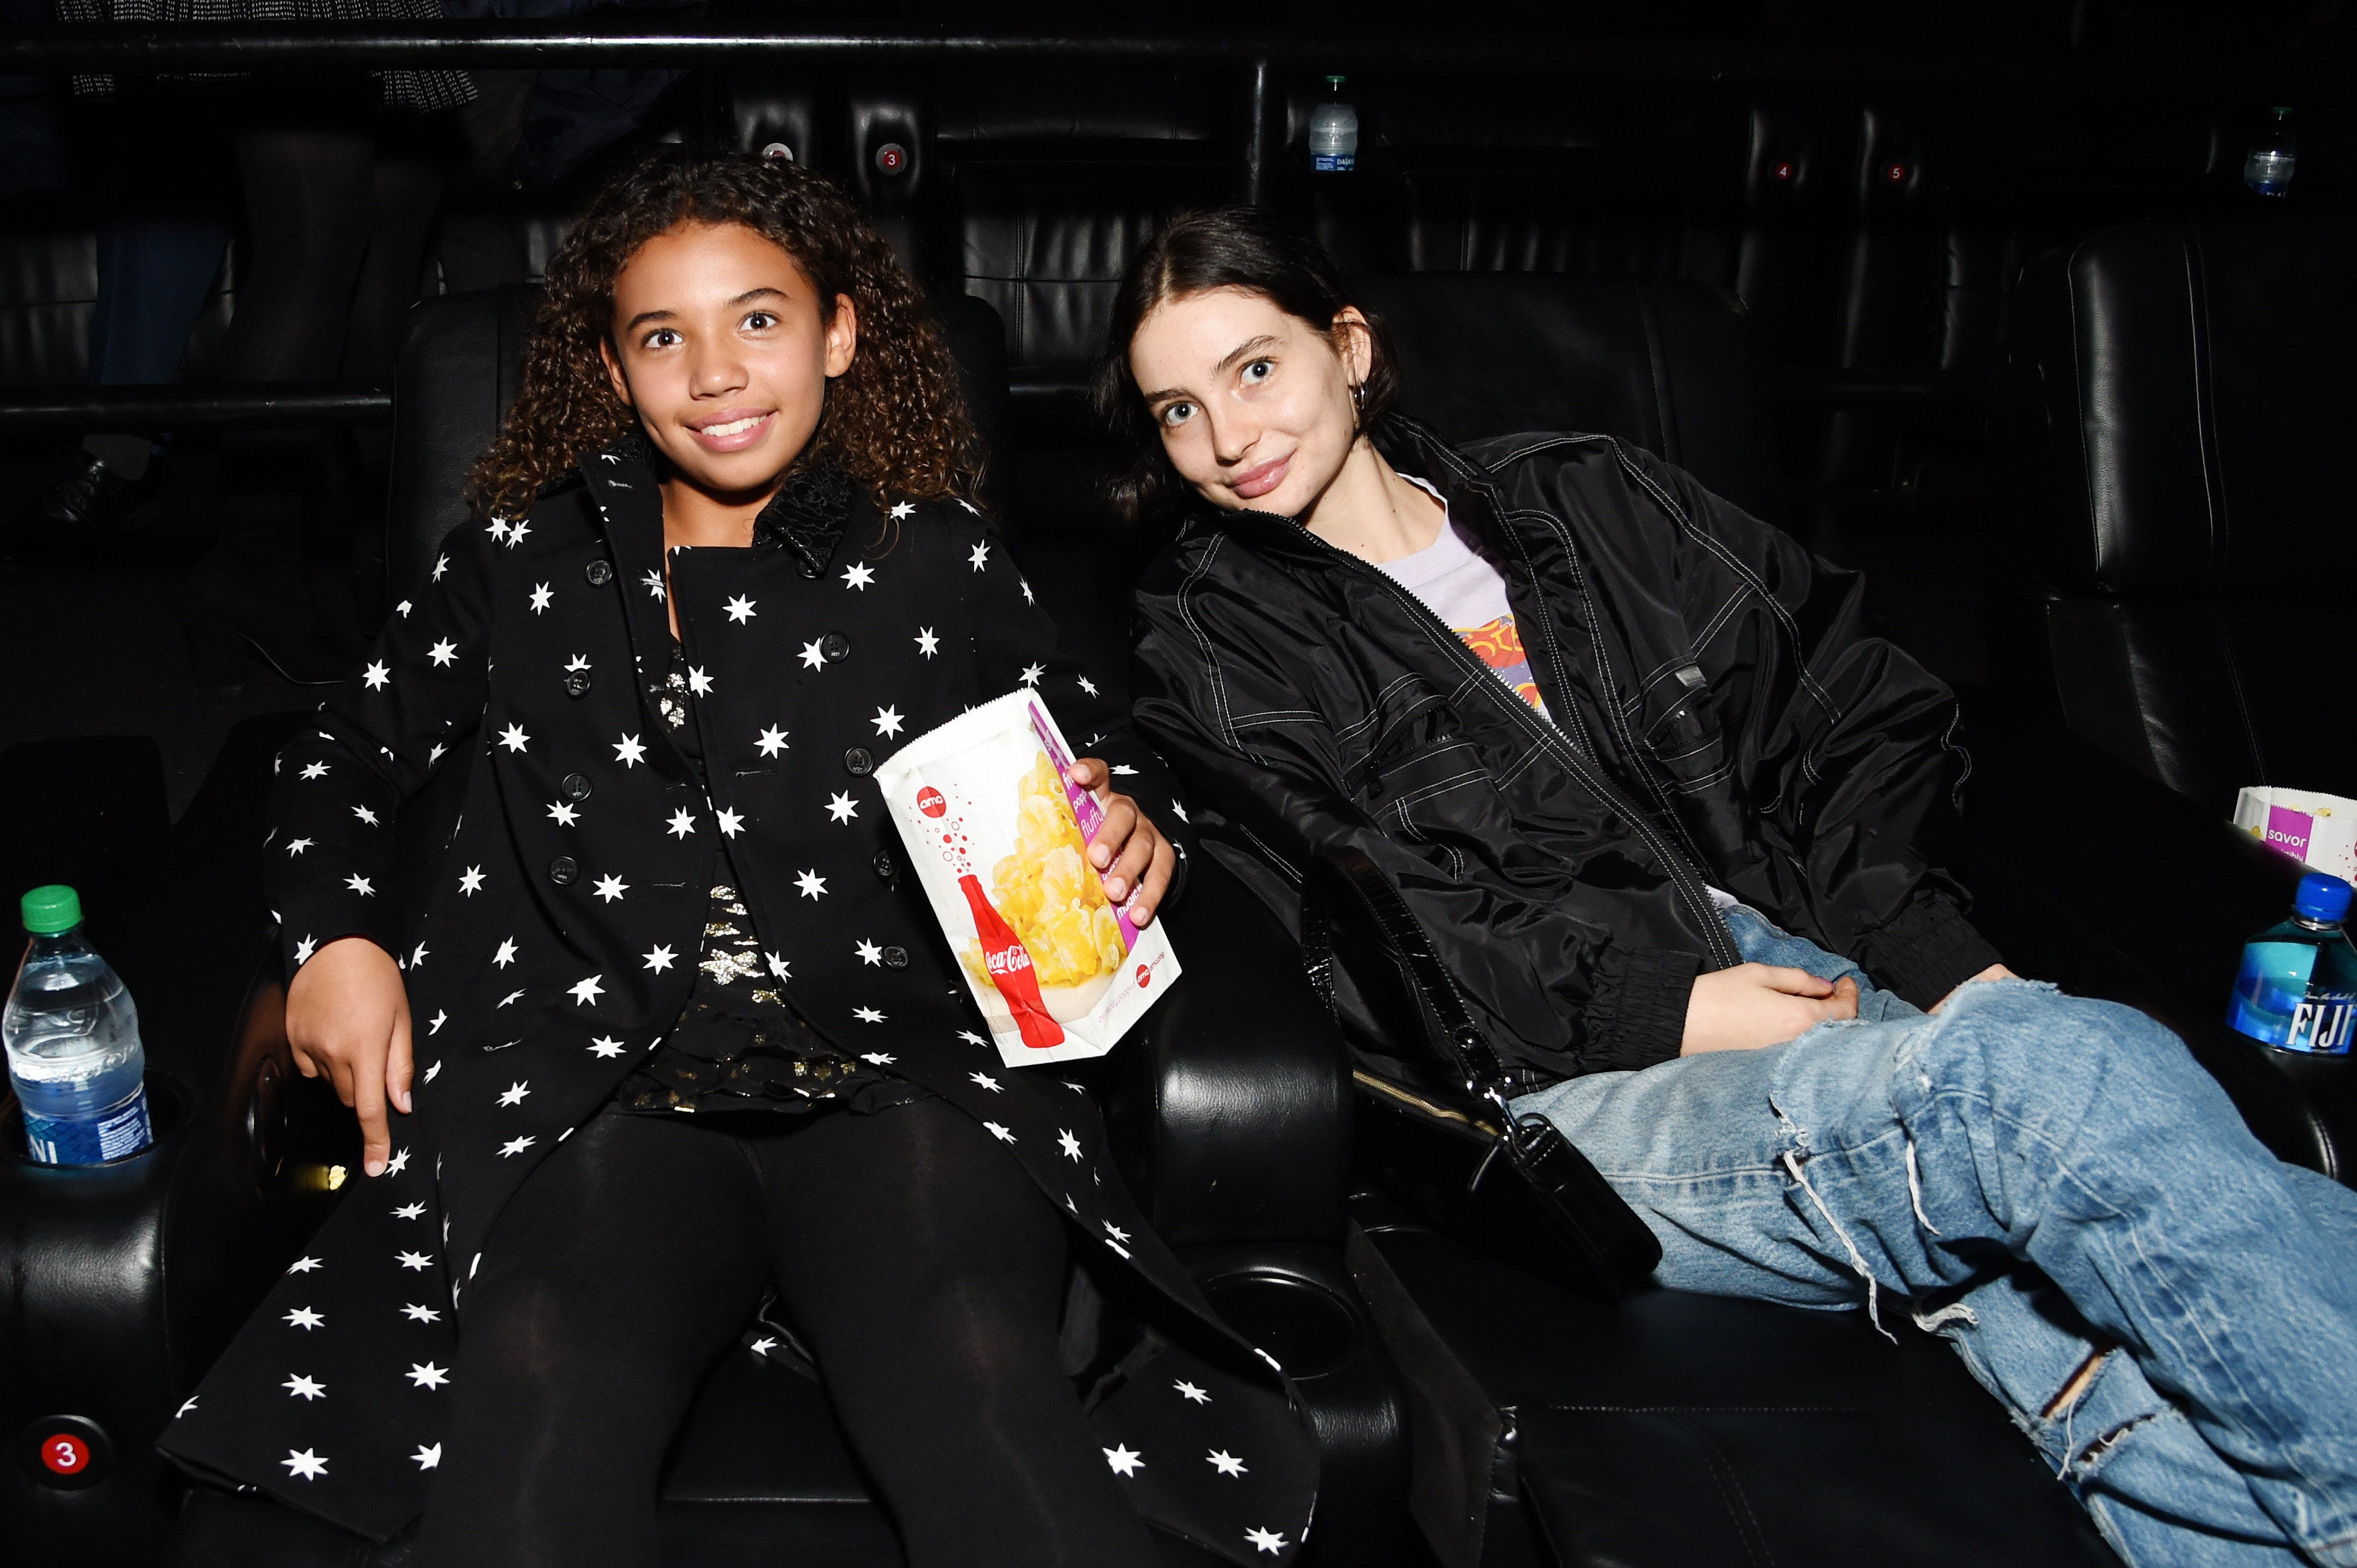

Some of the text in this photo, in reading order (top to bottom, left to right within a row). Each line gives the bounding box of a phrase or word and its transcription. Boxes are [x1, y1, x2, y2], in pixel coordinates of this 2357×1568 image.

[888, 154, 895, 166] 3
[1780, 166, 1786, 177] 4
[1892, 168, 1900, 179] 5
[920, 795, 944, 809] amc
[2267, 829, 2307, 847] savor
[1137, 968, 1150, 983] amc
[2284, 1003, 2354, 1047] FIJI
[56, 1442, 77, 1467] 3
